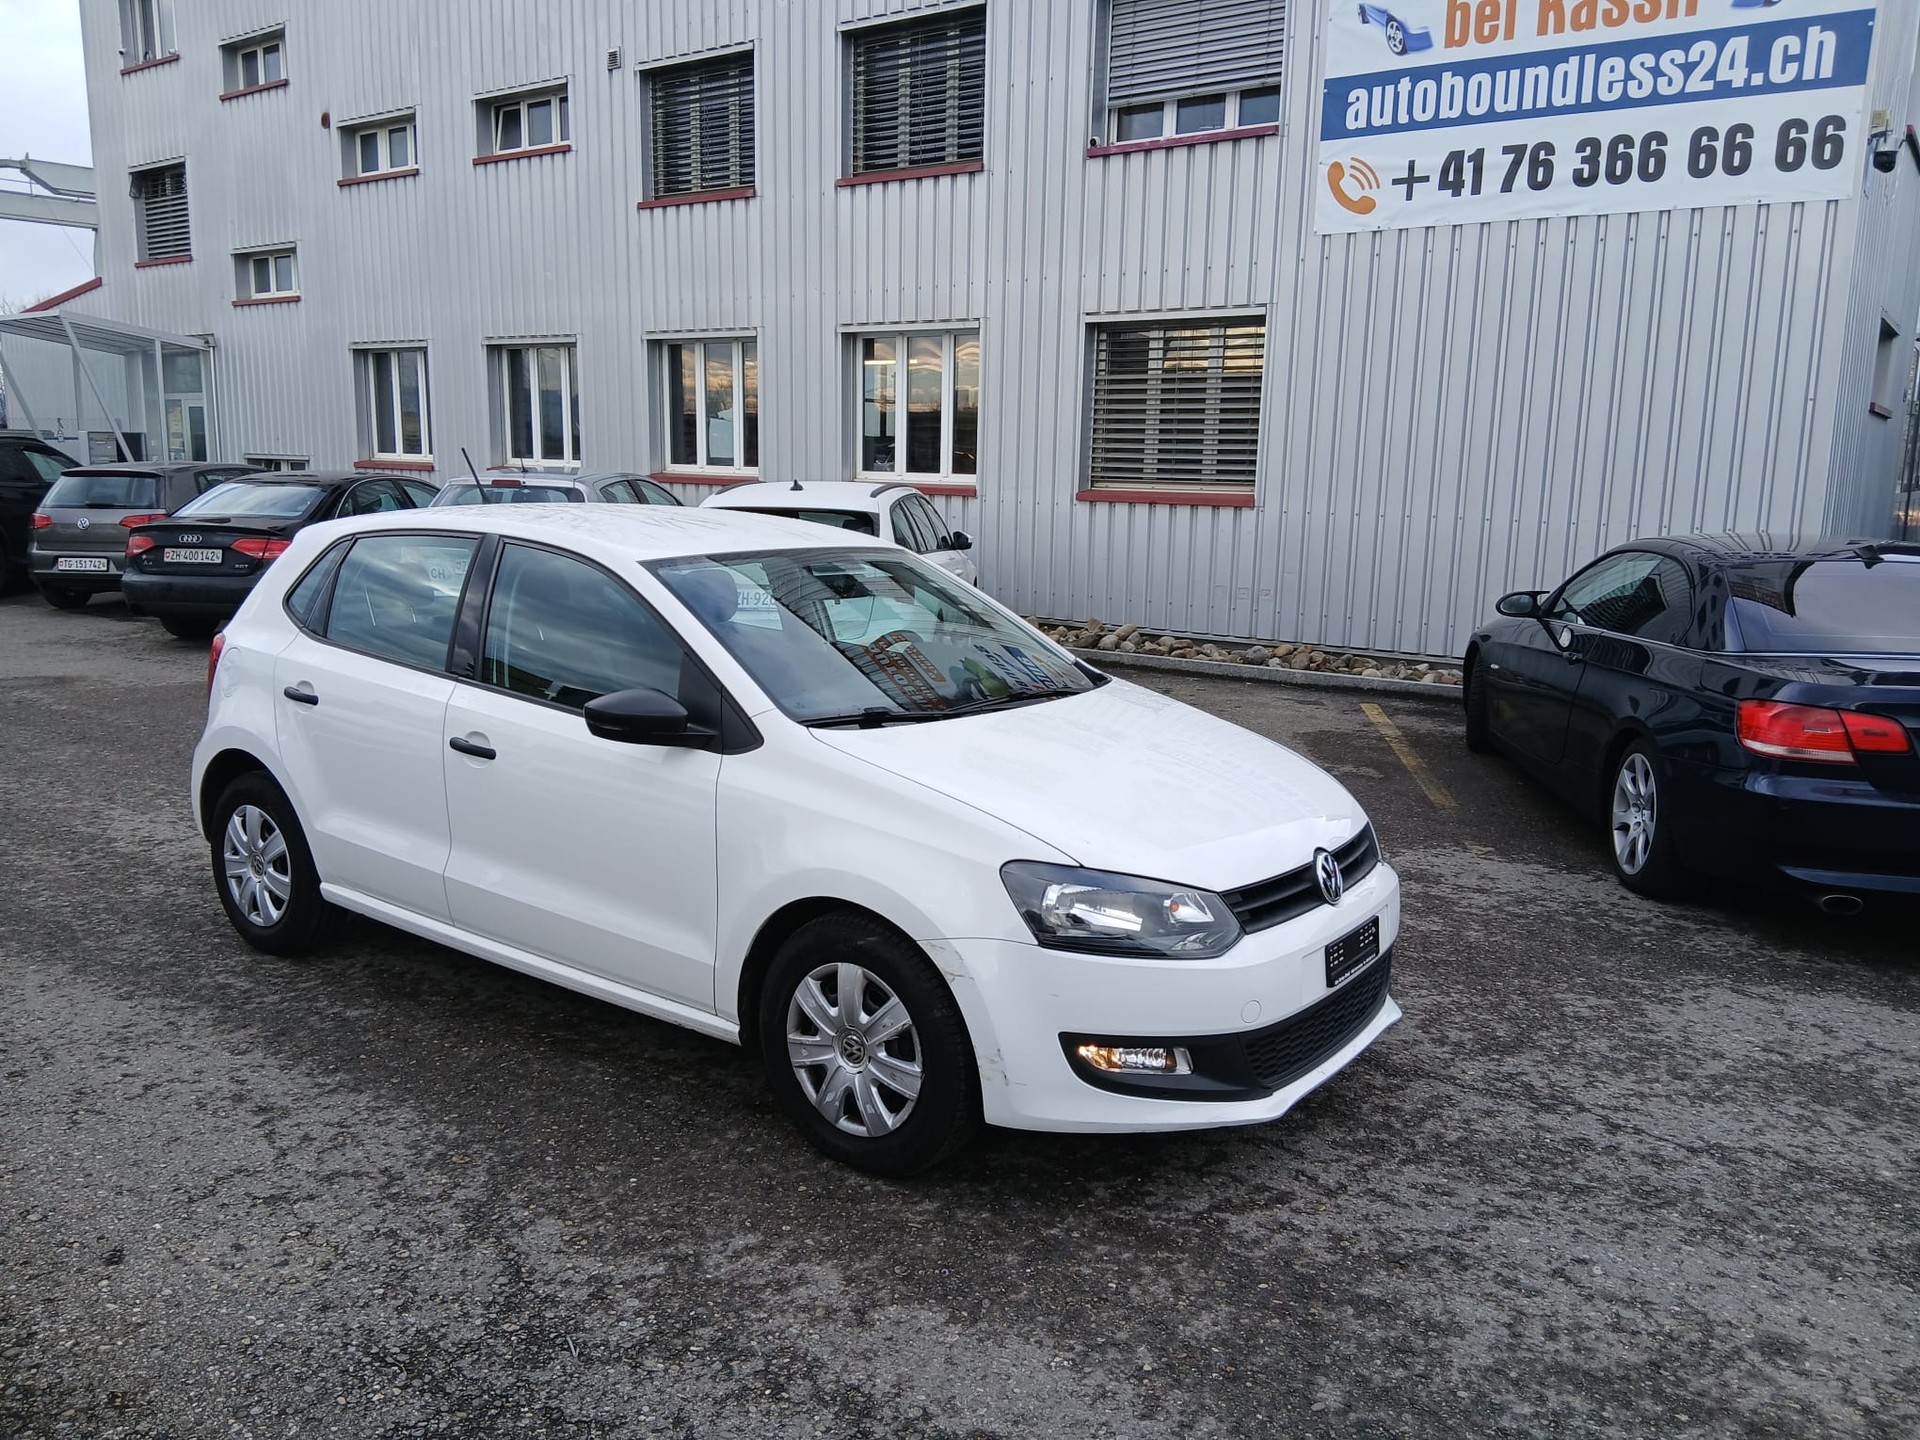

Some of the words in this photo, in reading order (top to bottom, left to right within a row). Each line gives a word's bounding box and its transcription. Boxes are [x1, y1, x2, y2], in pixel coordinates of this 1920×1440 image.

[1345, 26, 1837, 130] autoboundless24.ch
[1500, 141, 1556, 193] 76
[1572, 131, 1668, 187] 366
[1687, 123, 1754, 178] 66
[1775, 115, 1847, 172] 66
